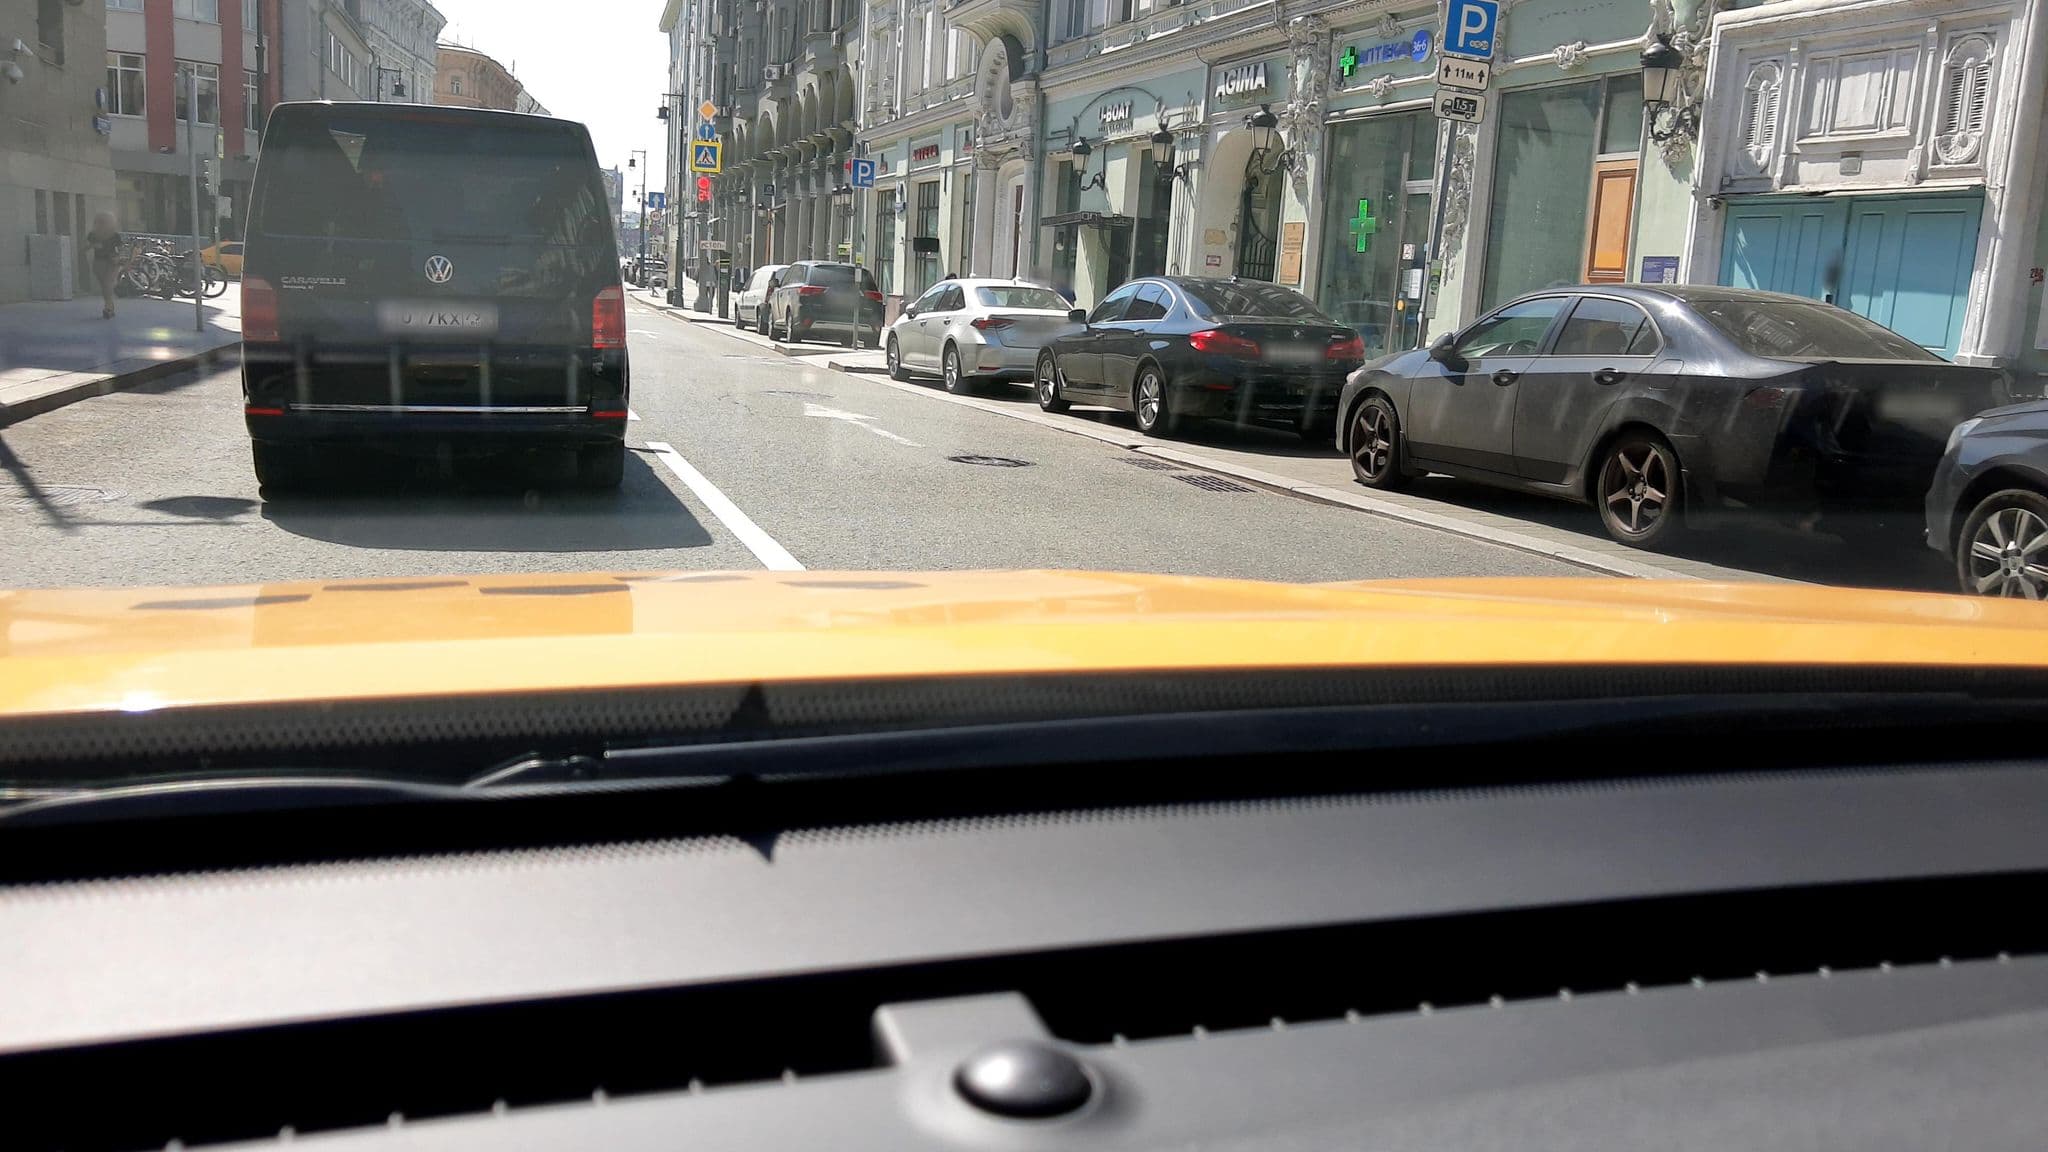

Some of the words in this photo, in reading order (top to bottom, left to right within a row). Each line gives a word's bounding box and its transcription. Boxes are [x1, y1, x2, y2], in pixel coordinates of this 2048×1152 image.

[1215, 63, 1267, 97] AGIMA
[1098, 101, 1132, 123] U-BOAT
[281, 276, 346, 285] CARAVELLE
